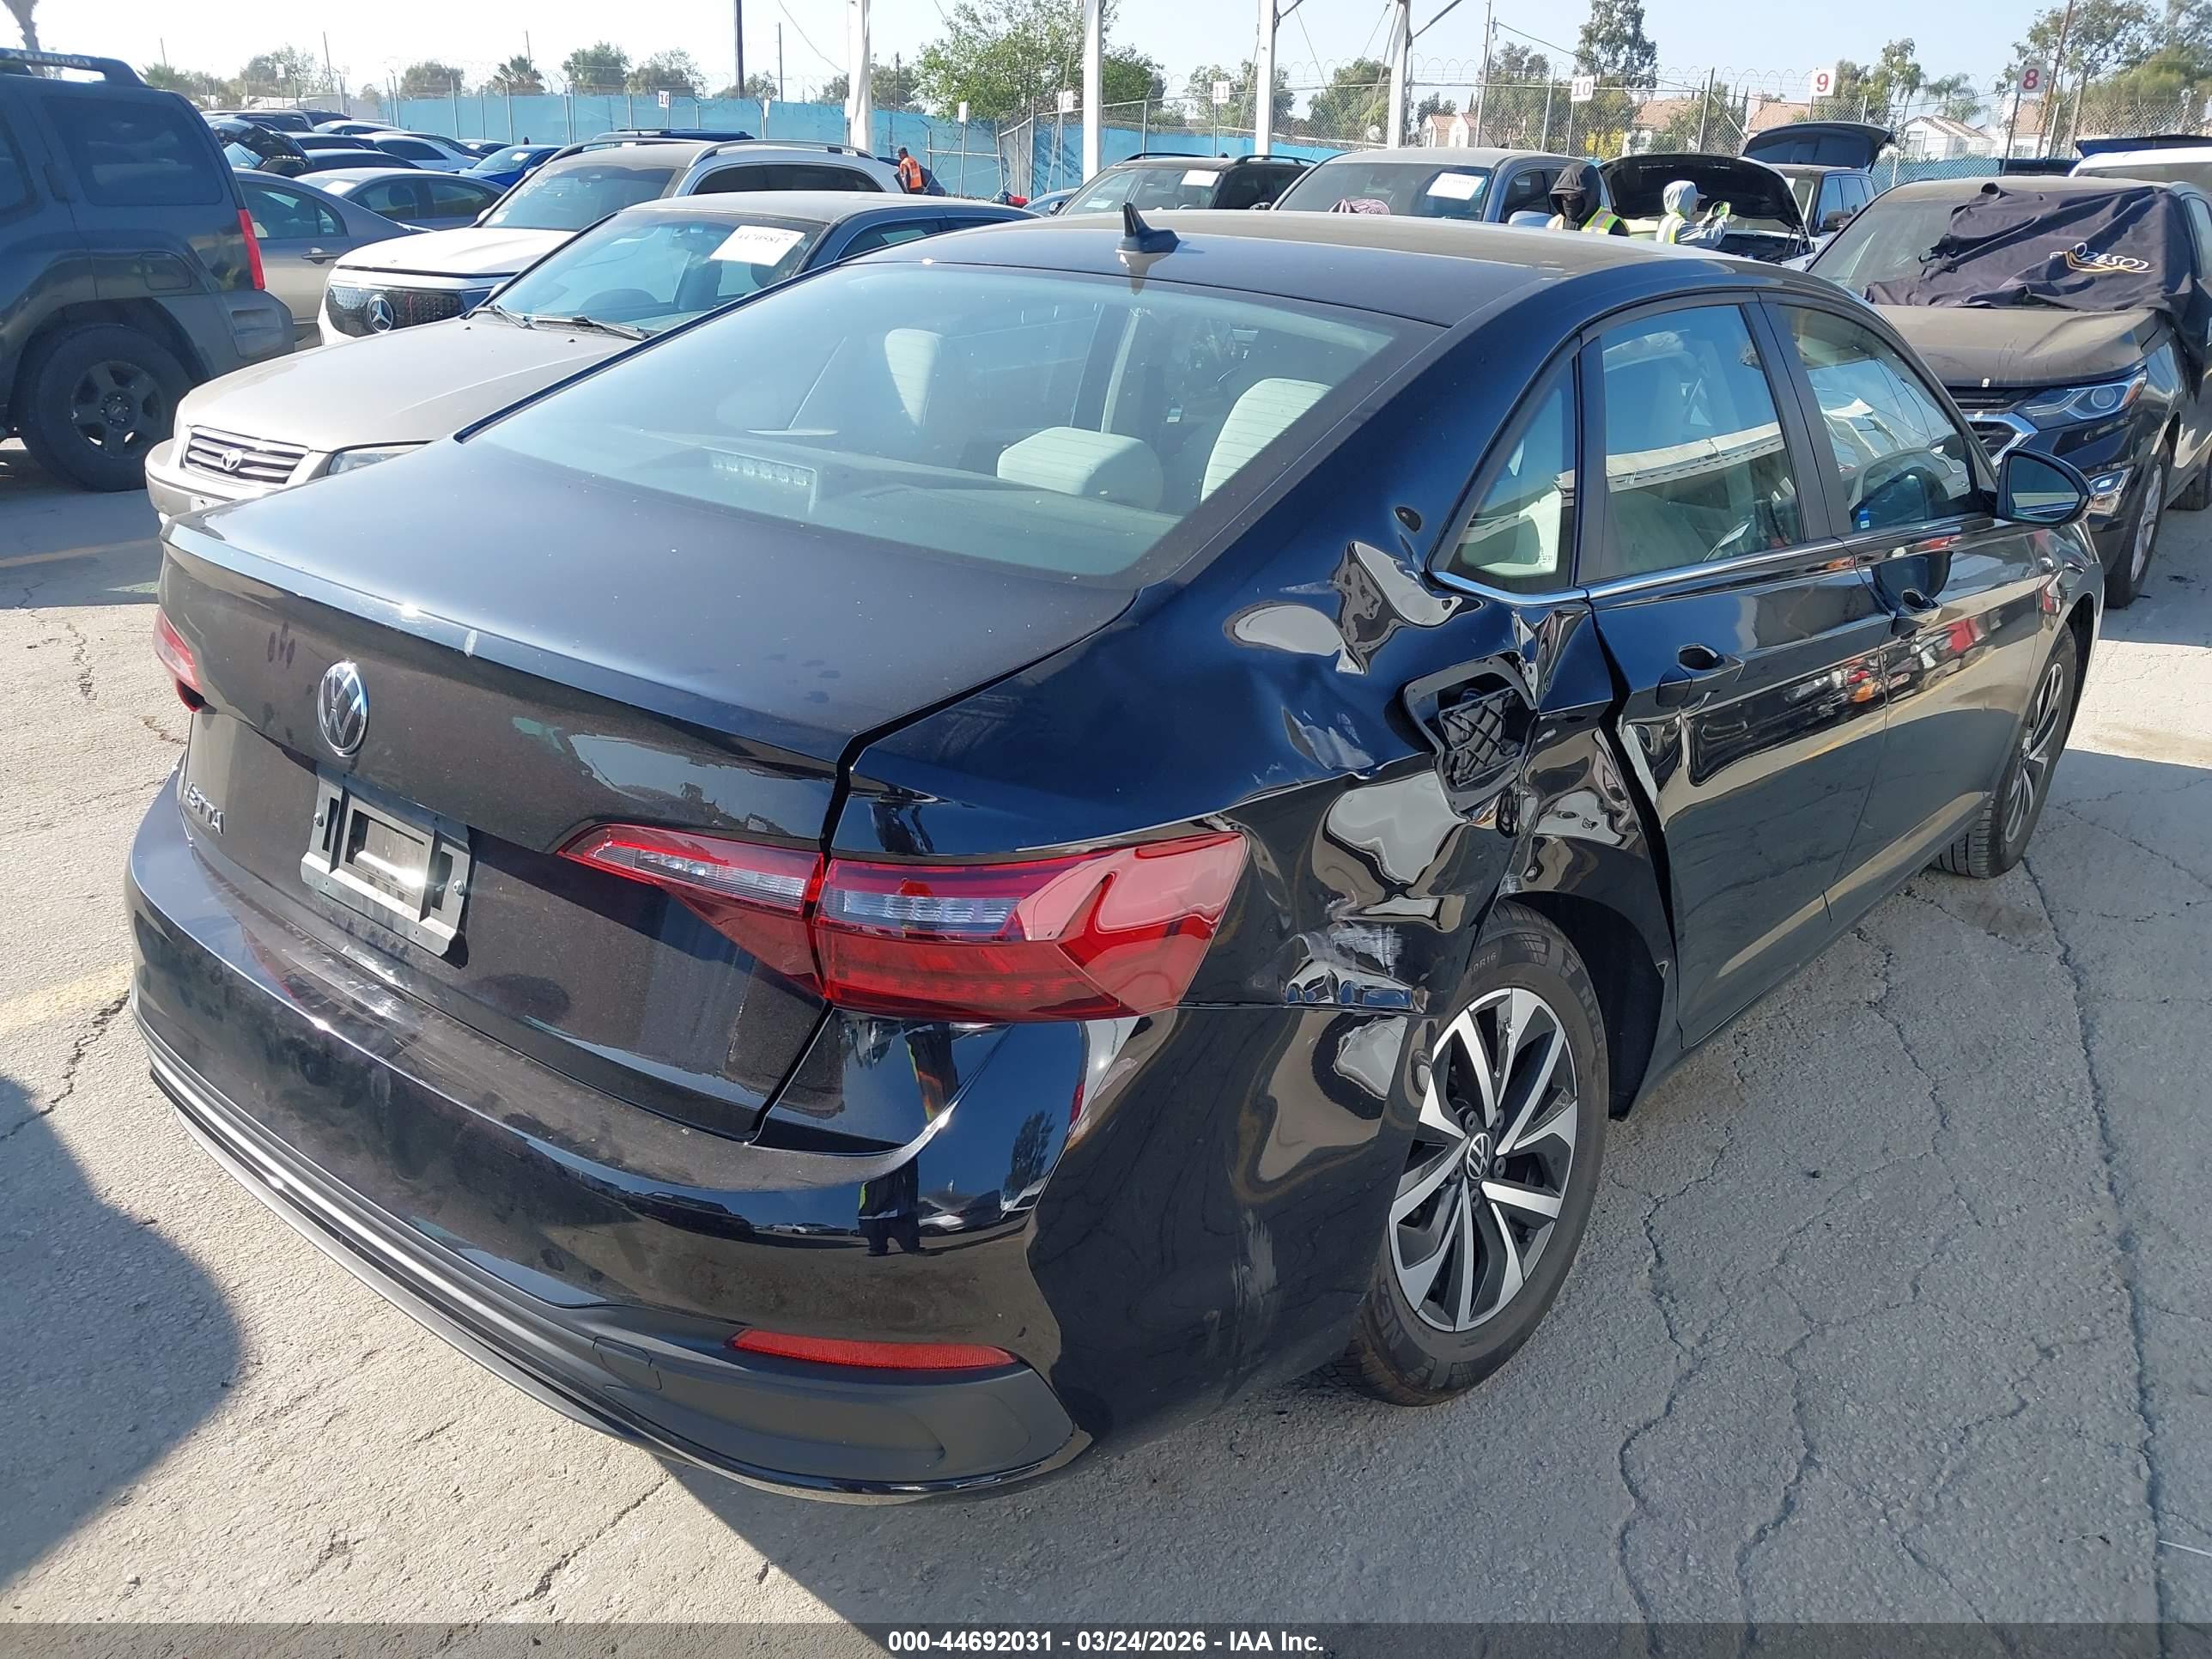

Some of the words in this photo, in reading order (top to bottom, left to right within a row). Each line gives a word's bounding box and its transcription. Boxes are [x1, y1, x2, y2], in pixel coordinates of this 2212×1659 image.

[1816, 73, 1829, 93] 9
[2023, 68, 2039, 89] 8
[1214, 86, 1228, 99] 11
[1573, 81, 1592, 97] 10
[184, 781, 225, 836] JETTA
